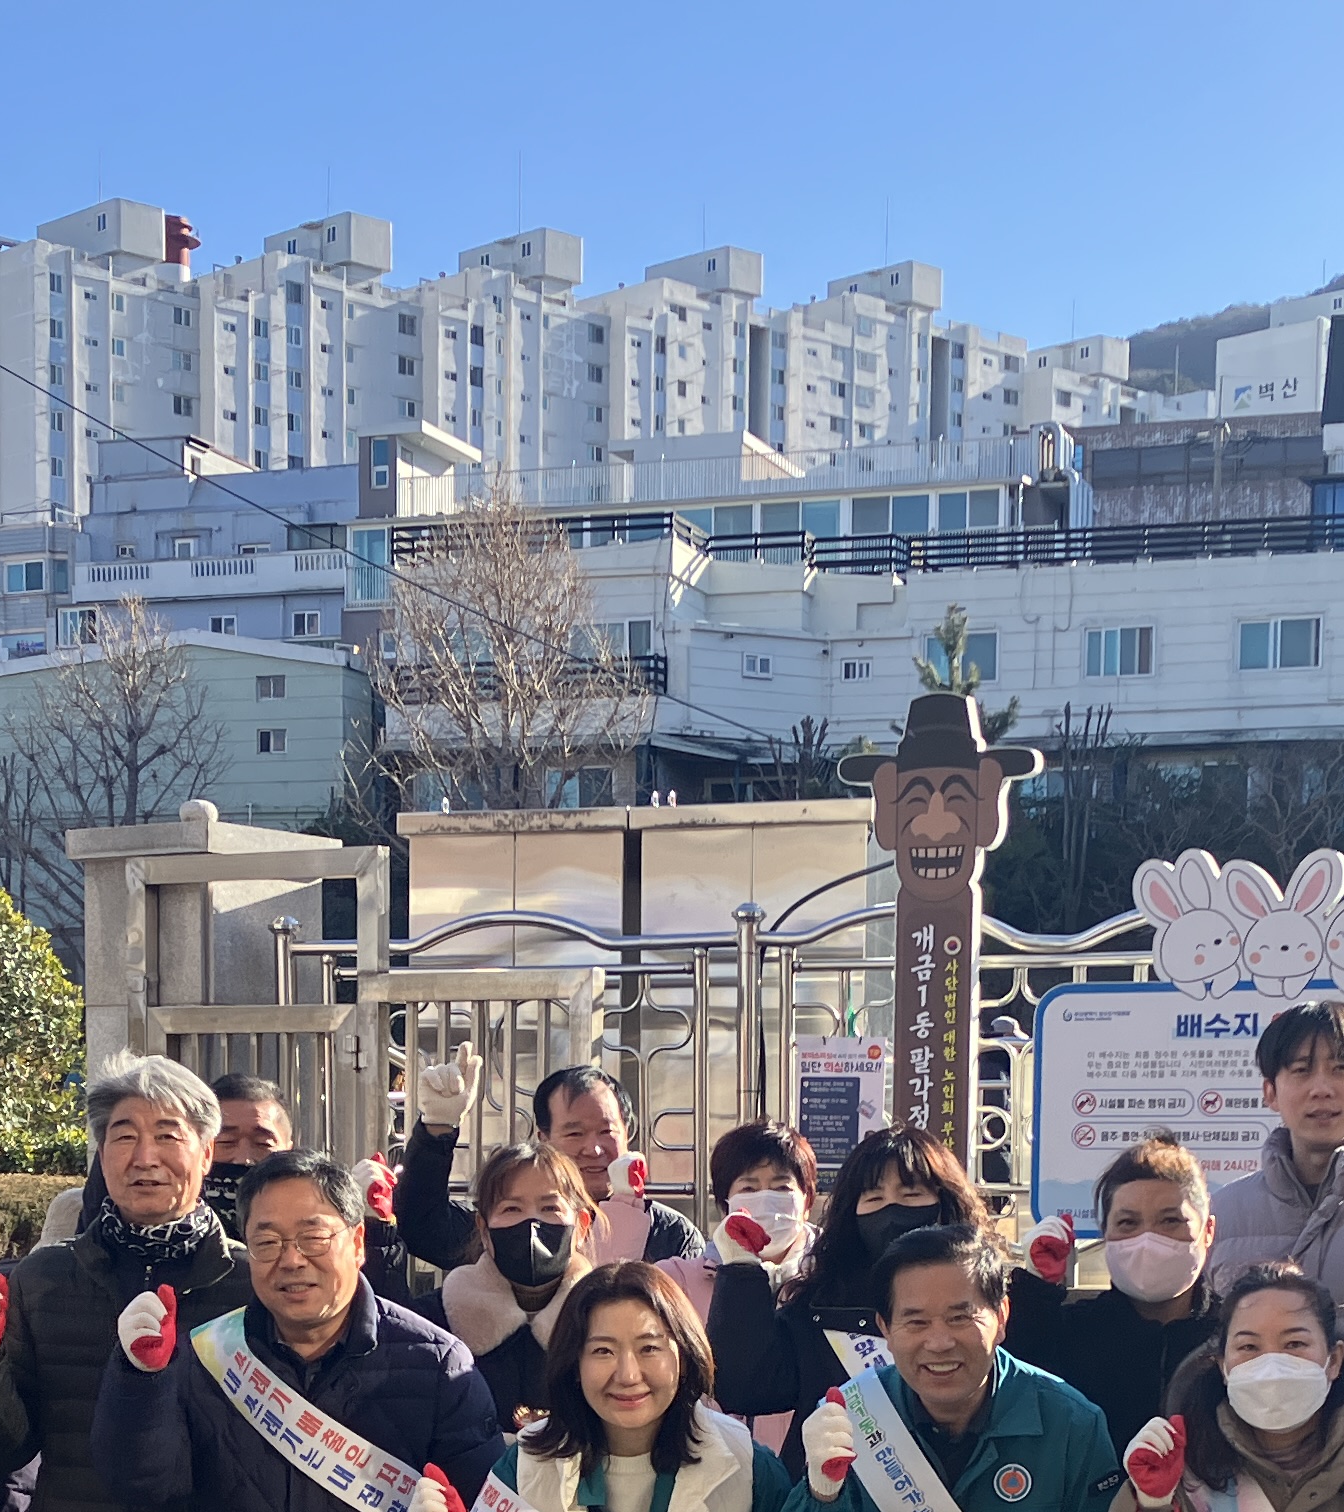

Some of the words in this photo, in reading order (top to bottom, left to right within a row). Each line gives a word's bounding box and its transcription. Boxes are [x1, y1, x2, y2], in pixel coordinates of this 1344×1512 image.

[1259, 377, 1298, 402] 벽산
[909, 923, 936, 1040] 개금1동
[944, 958, 959, 1025] 사단법인
[1176, 1013, 1259, 1038] 배수지
[943, 1030, 956, 1062] 대한
[801, 1062, 821, 1074] 일단
[824, 1062, 882, 1073] 의심하세요!!
[908, 1046, 934, 1131] 팔각정
[941, 1069, 956, 1116] 노인회
[1099, 1099, 1125, 1109] 시설물
[1167, 1098, 1186, 1108] 금지
[1241, 1131, 1259, 1141] 금지
[234, 1350, 293, 1415] 쓰레기
[295, 1410, 372, 1470] 배출은
[223, 1368, 242, 1395] 내
[243, 1394, 326, 1471] 쓰레기는
[326, 1464, 356, 1492] 내
[357, 1483, 384, 1509] 집
